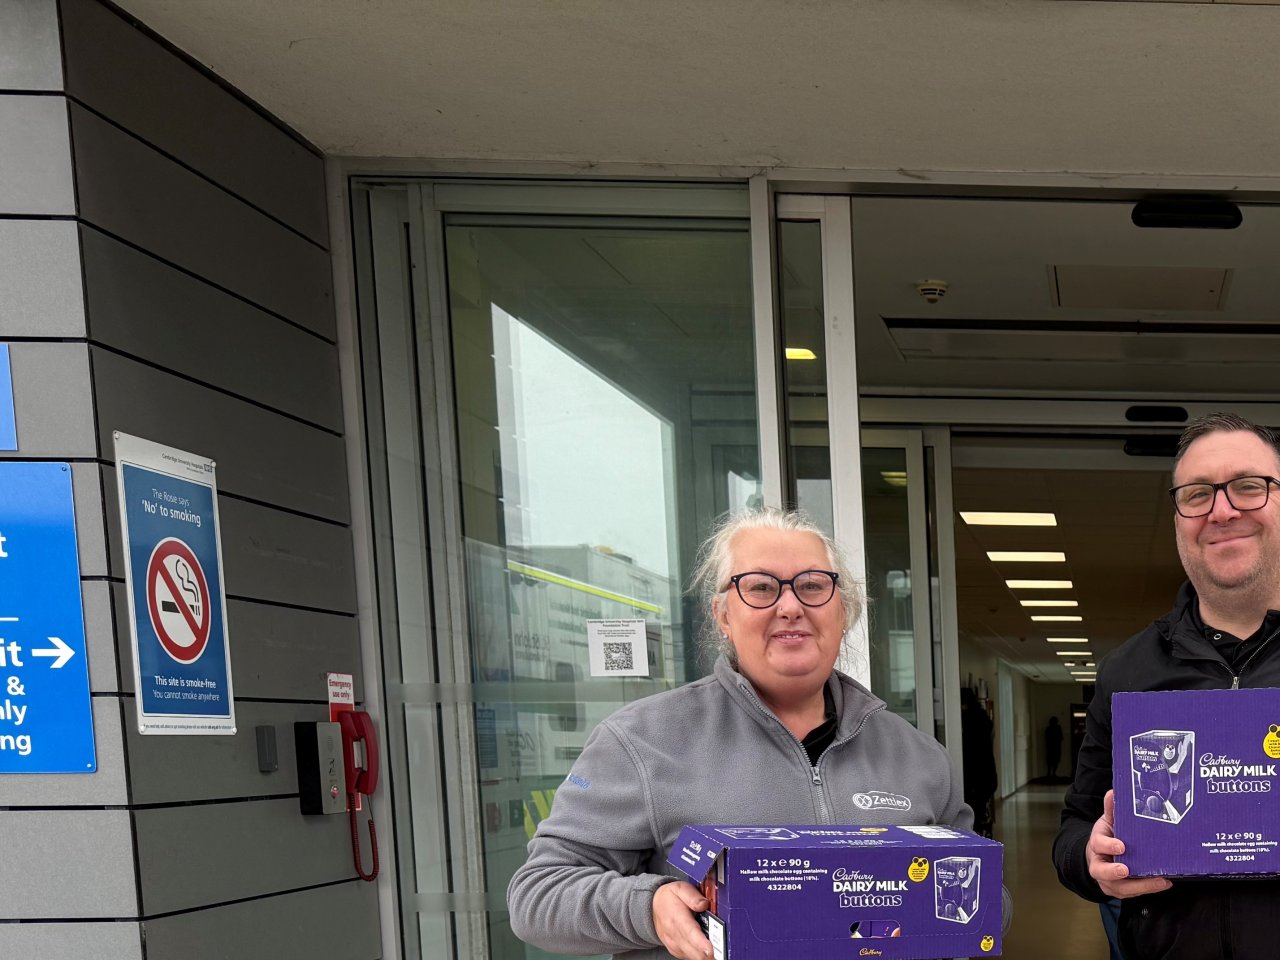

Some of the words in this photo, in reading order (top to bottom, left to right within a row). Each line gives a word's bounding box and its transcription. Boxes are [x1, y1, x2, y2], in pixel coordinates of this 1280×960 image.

[152, 488, 162, 499] The
[163, 491, 178, 504] Rosie
[178, 496, 190, 508] says
[159, 504, 168, 517] to
[170, 508, 201, 527] smoking
[7, 676, 26, 696] &
[154, 675, 168, 686] This
[168, 676, 180, 687] site
[180, 677, 186, 687] is
[185, 678, 217, 689] smoke-free
[329, 679, 352, 690] Emergency
[152, 689, 163, 699] You
[163, 690, 181, 700] cannot
[181, 691, 198, 700] smoke
[198, 692, 220, 703] anywhere
[340, 690, 351, 700] only
[1199, 752, 1241, 767] Cadbury
[1200, 765, 1243, 778] DAIRY
[1243, 764, 1277, 777] MILK
[1206, 778, 1271, 793] buttons
[872, 795, 909, 808] Zettlex
[1216, 832, 1226, 840] 12
[1243, 832, 1255, 840] 90
[1256, 833, 1262, 841] g
[756, 859, 769, 867] 12
[789, 858, 801, 867] 90
[803, 860, 810, 868] g
[832, 867, 874, 883] Cadbury
[767, 883, 802, 891] 4322804
[833, 880, 874, 892] DAIRY
[875, 880, 909, 892] MILK
[839, 893, 903, 908] buttons
[859, 947, 882, 957] Cadbury
